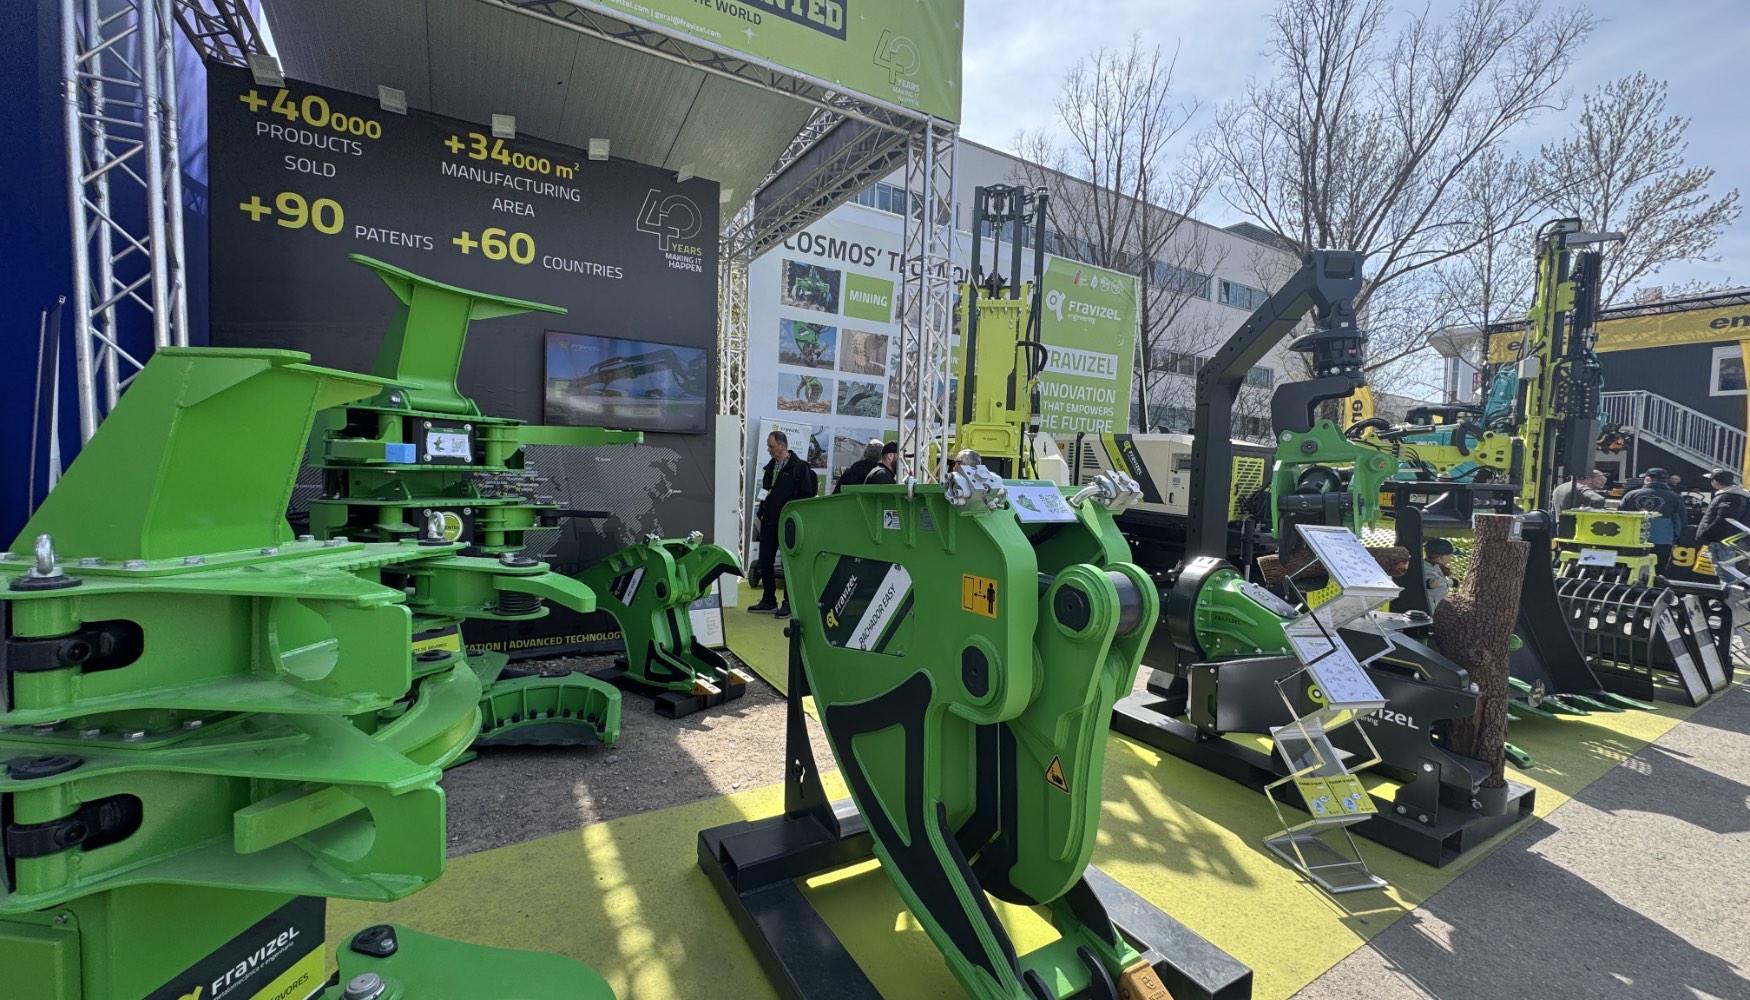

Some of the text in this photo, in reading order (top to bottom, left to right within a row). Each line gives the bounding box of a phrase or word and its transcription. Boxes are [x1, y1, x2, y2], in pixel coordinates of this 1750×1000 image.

[716, 0, 762, 25] WORLD
[256, 121, 363, 156] PRODUCTS
[444, 132, 551, 174] +34000
[284, 155, 336, 178] SOLD
[441, 161, 581, 202] MANUFACTURING
[492, 197, 535, 218] AREA
[239, 191, 434, 251] +90 PATENTS
[452, 227, 623, 279] +60 COUNTRIES
[665, 252, 694, 264] MAKING
[671, 242, 702, 257] YEARS
[668, 260, 702, 273] HAPPEN
[849, 290, 888, 307] MINING
[1047, 350, 1115, 376] RAVIZEL
[1040, 381, 1116, 404] NNOVATION
[1043, 400, 1114, 417] THAT EMPOWERS
[1040, 413, 1113, 434] HE FUTURE
[858, 583, 896, 645] RACHADOR EASY
[1214, 615, 1242, 625] FRAVIZEL
[509, 635, 563, 650] ADVANCED
[265, 941, 294, 965] engenharia
